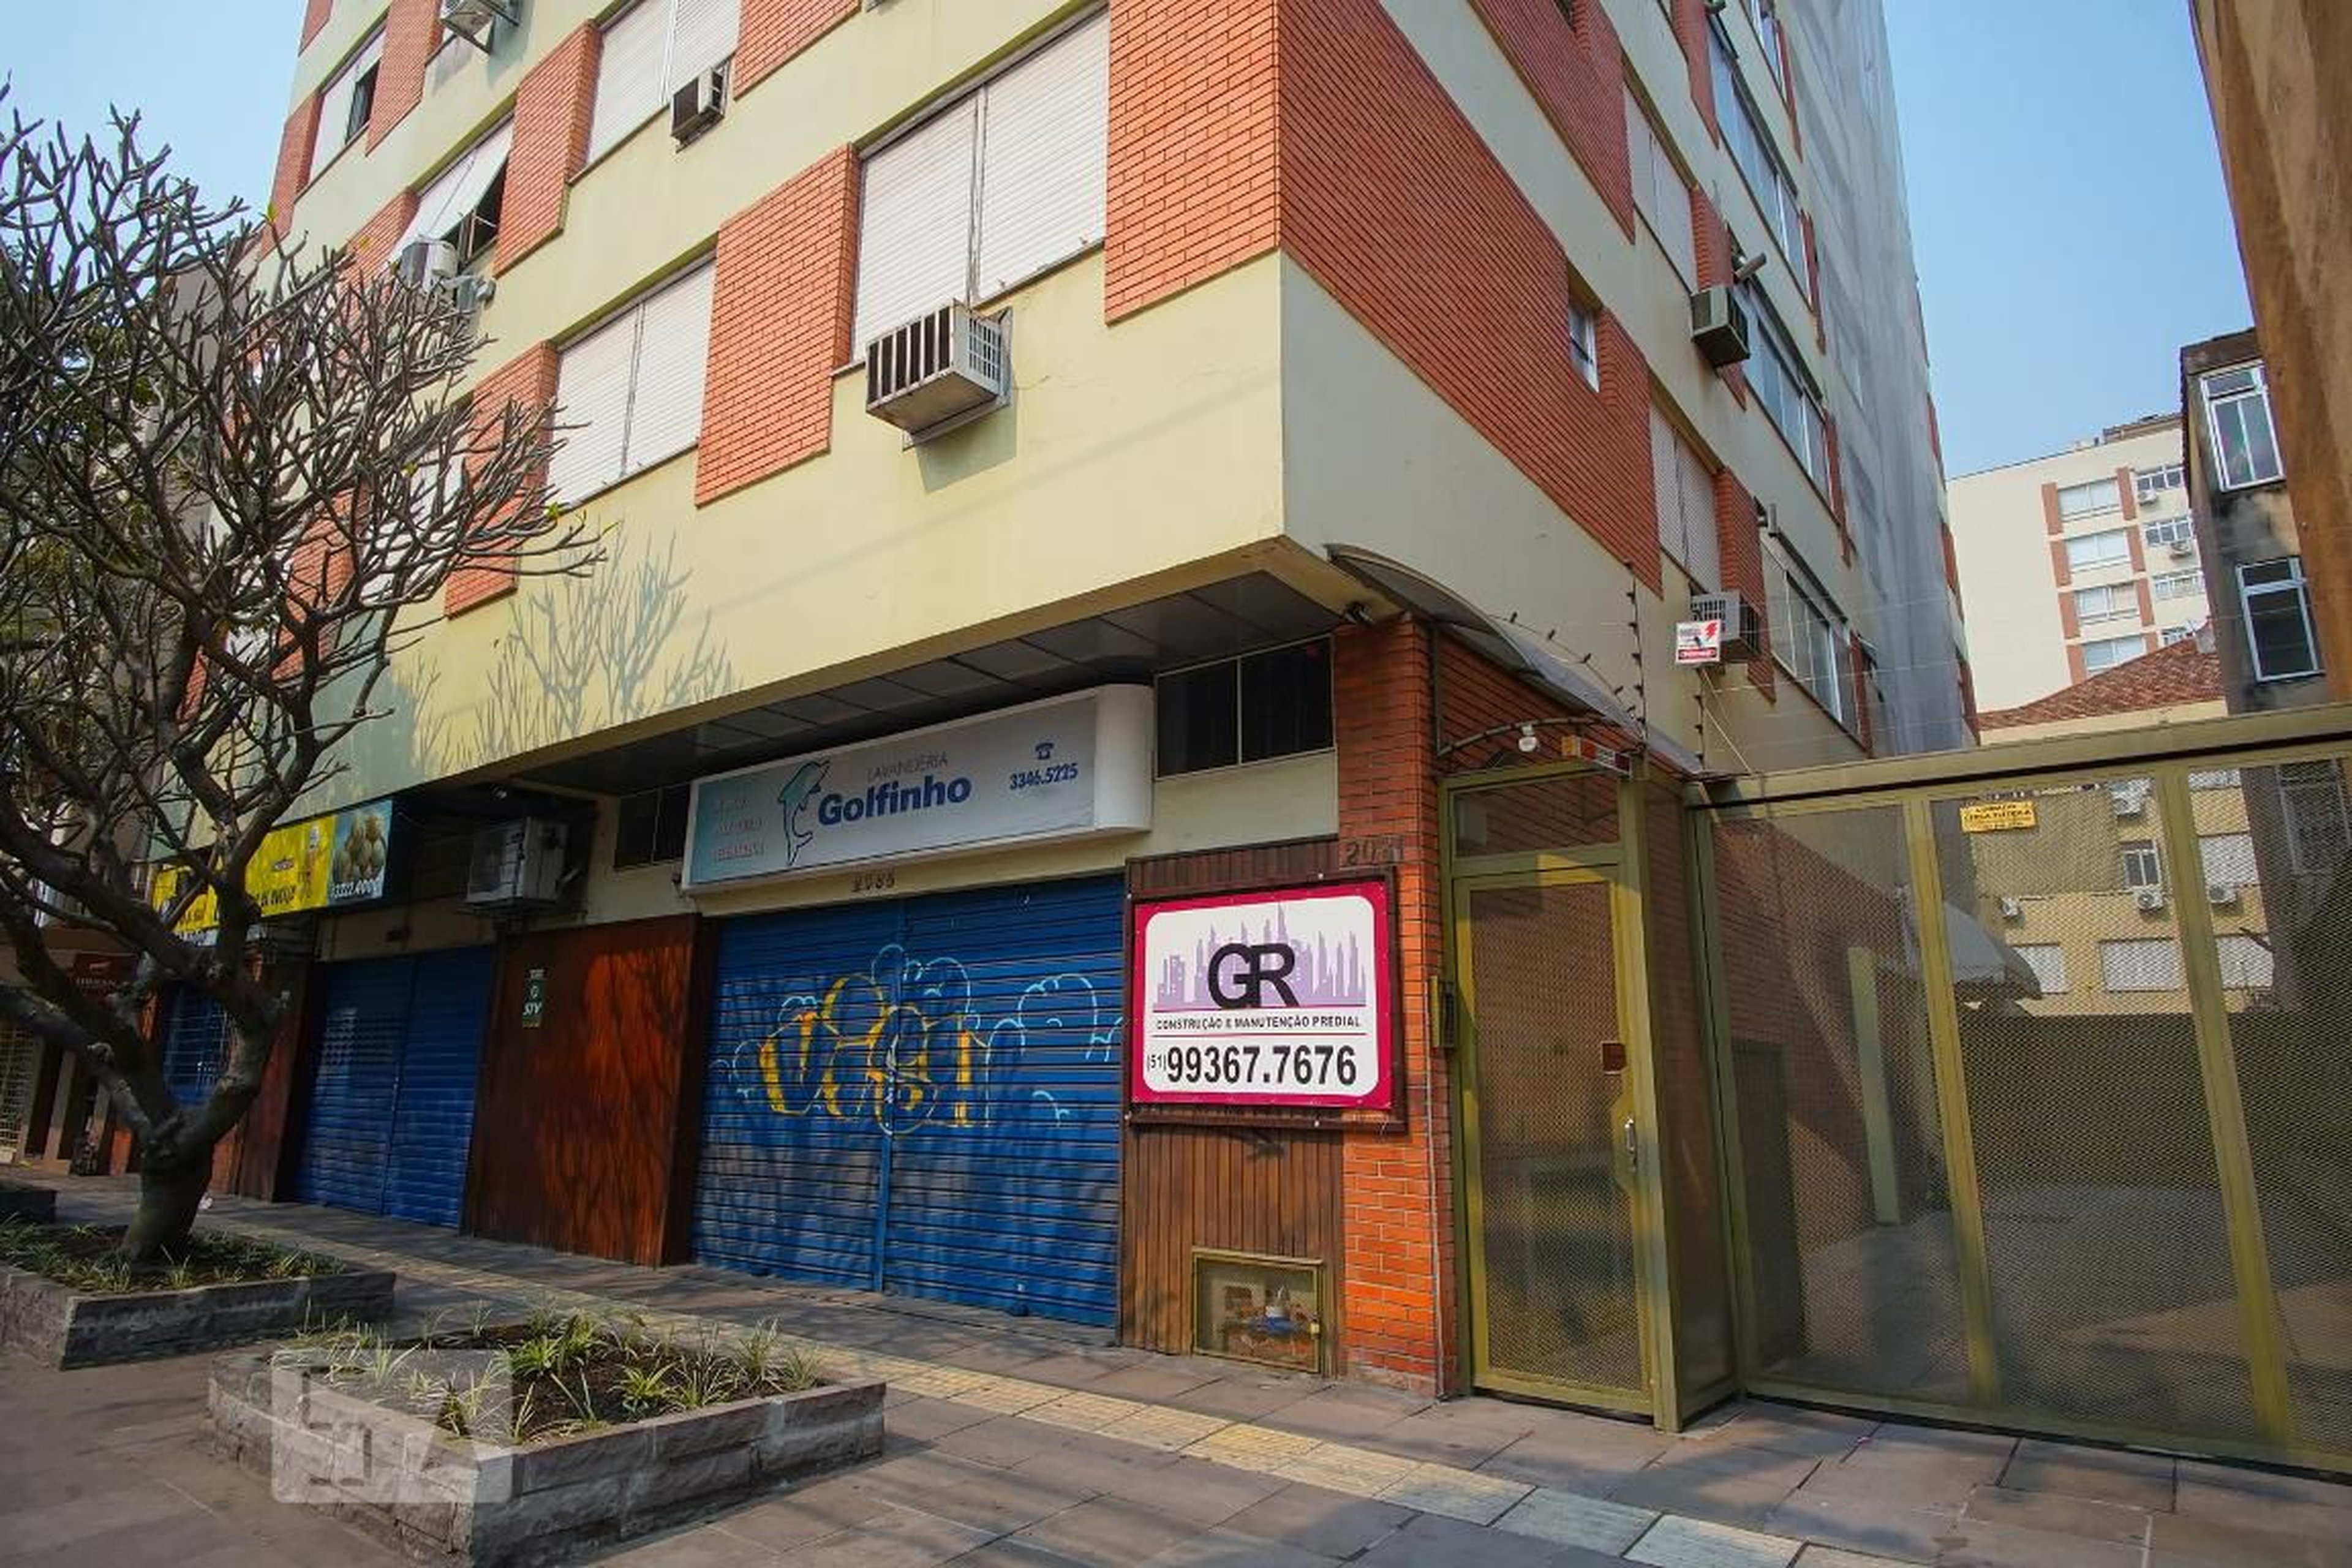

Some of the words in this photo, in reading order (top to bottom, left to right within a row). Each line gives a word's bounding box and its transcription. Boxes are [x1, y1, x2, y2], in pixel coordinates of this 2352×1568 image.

[818, 774, 972, 826] Golfinho
[1208, 943, 1300, 1009] GR
[1157, 1016, 1223, 1030] CONSTRUÇÃO
[1226, 1018, 1232, 1028] E
[1235, 1015, 1310, 1028] MANUTENÇÃO
[1312, 1015, 1360, 1028] PREDIAL
[1167, 1044, 1357, 1085] 99367.7676
